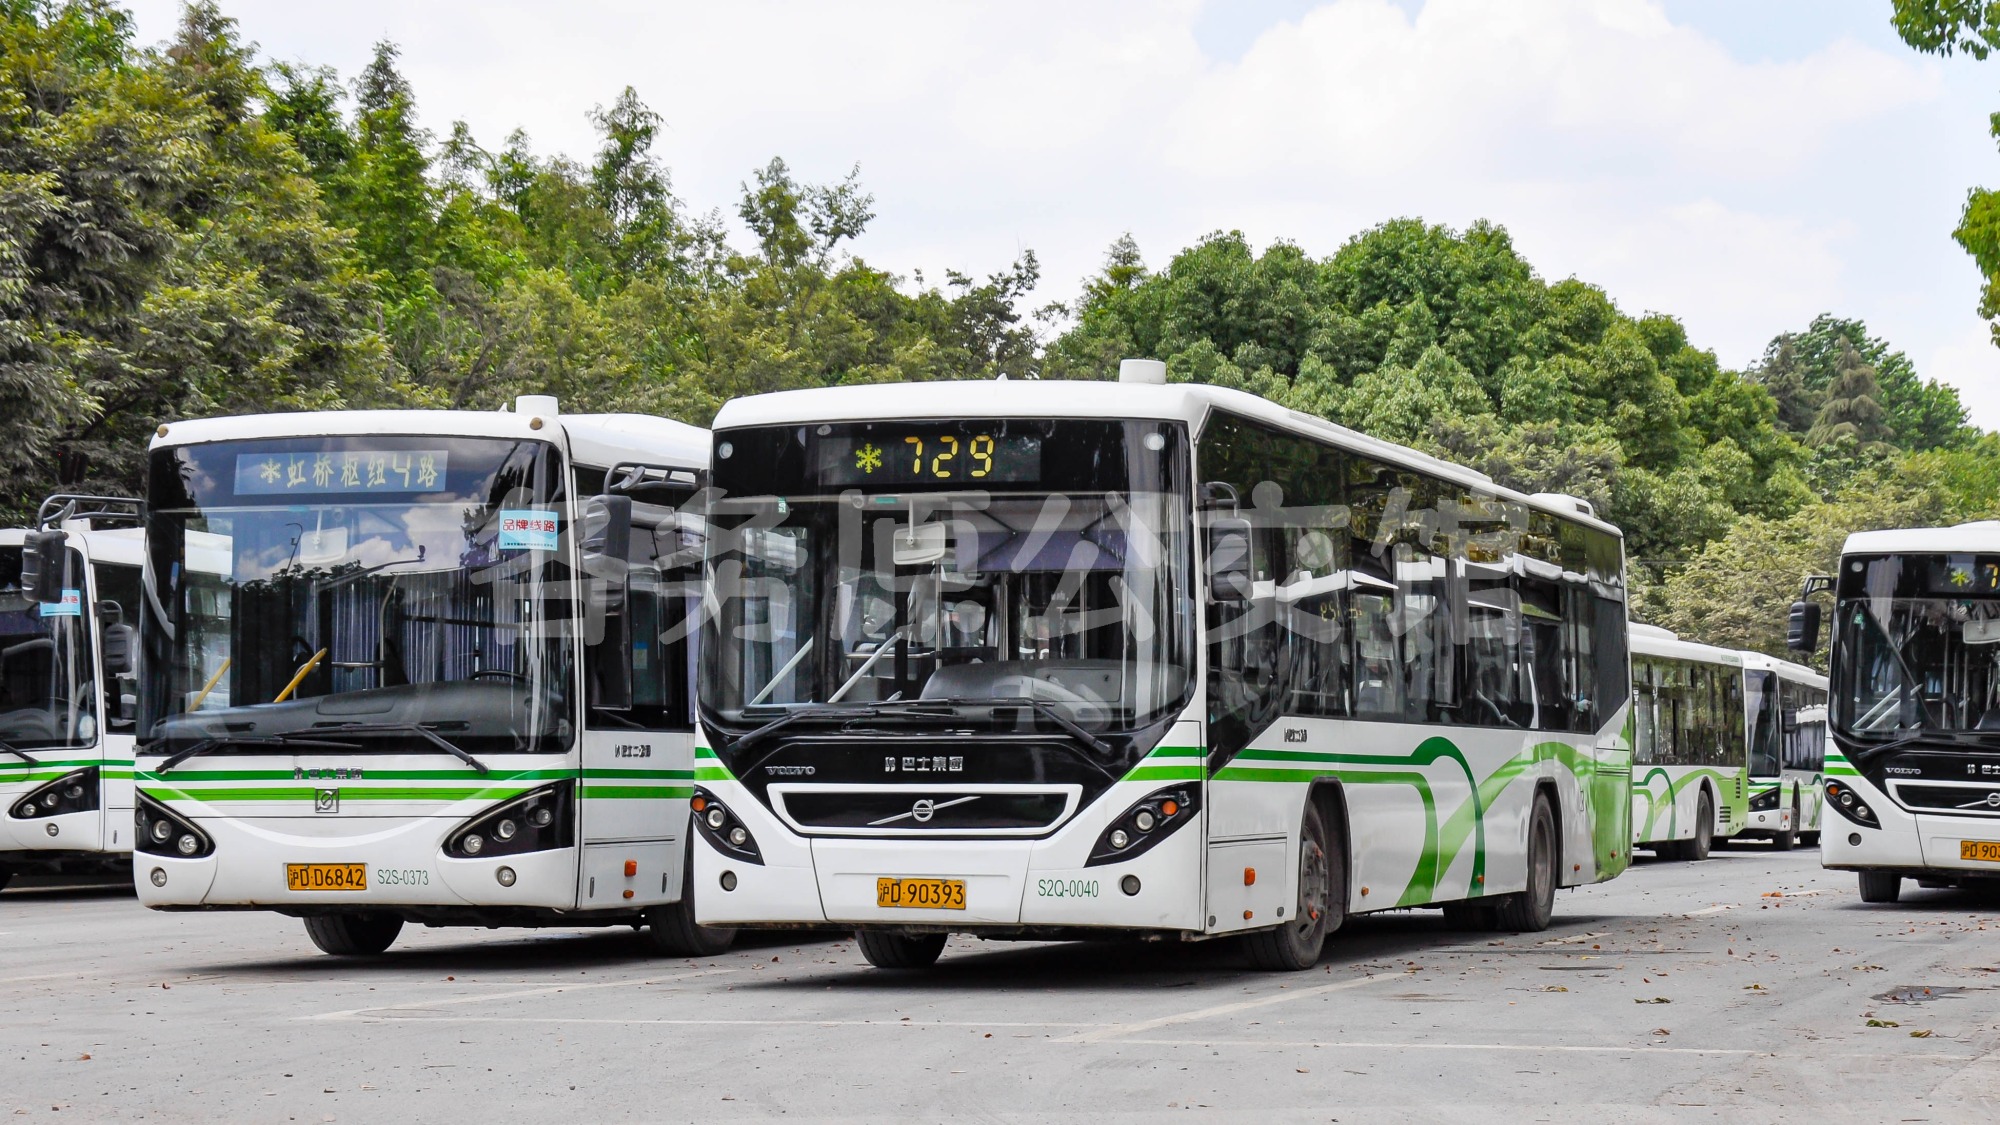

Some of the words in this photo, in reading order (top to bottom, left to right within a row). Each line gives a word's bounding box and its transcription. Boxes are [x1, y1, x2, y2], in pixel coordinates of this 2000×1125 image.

[905, 434, 994, 478] 729
[287, 453, 438, 488] 虹桥枢纽4路
[503, 519, 555, 532] 品牌线路
[765, 766, 815, 775] VOLVO
[377, 869, 429, 886] S2S-0373
[1038, 879, 1099, 897] S2Q-0040
